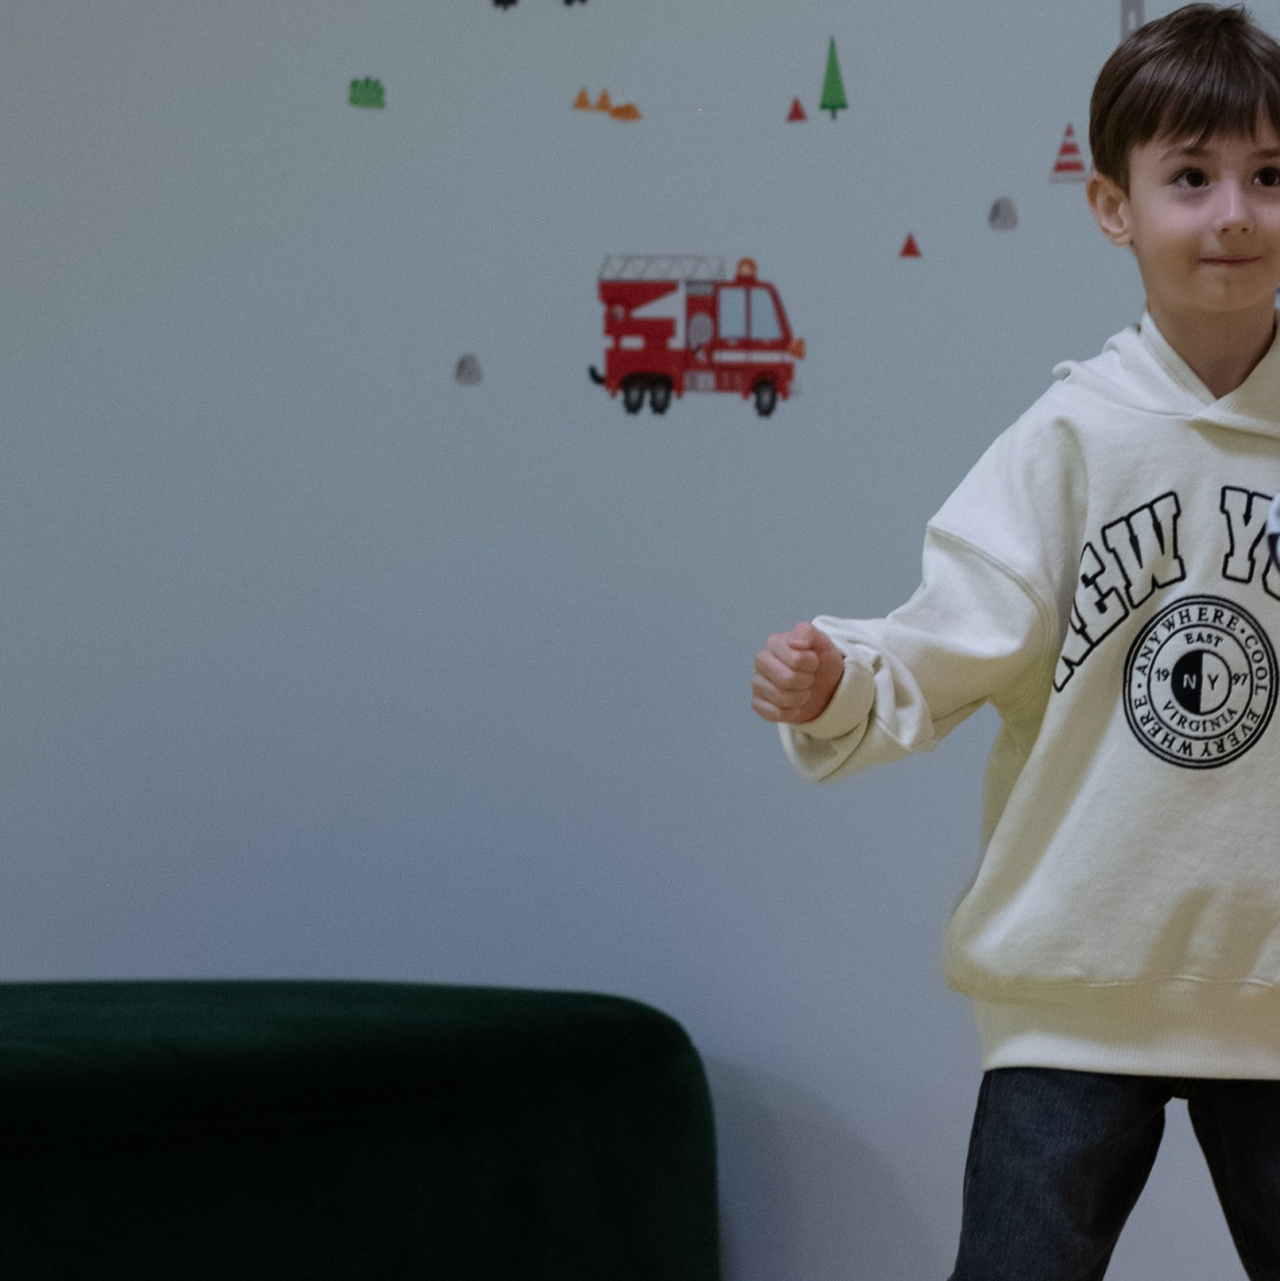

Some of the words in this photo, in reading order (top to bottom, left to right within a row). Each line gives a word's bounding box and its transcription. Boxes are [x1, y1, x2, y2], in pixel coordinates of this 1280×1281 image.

[1136, 606, 1240, 677] ANYWHERE
[1184, 631, 1224, 648] EAST
[1155, 668, 1171, 682] 19
[1232, 672, 1249, 687] 97
[1244, 634, 1268, 696] COOL
[1134, 694, 1262, 757] EVERYWHERE
[1162, 699, 1239, 733] VIRGINIA
